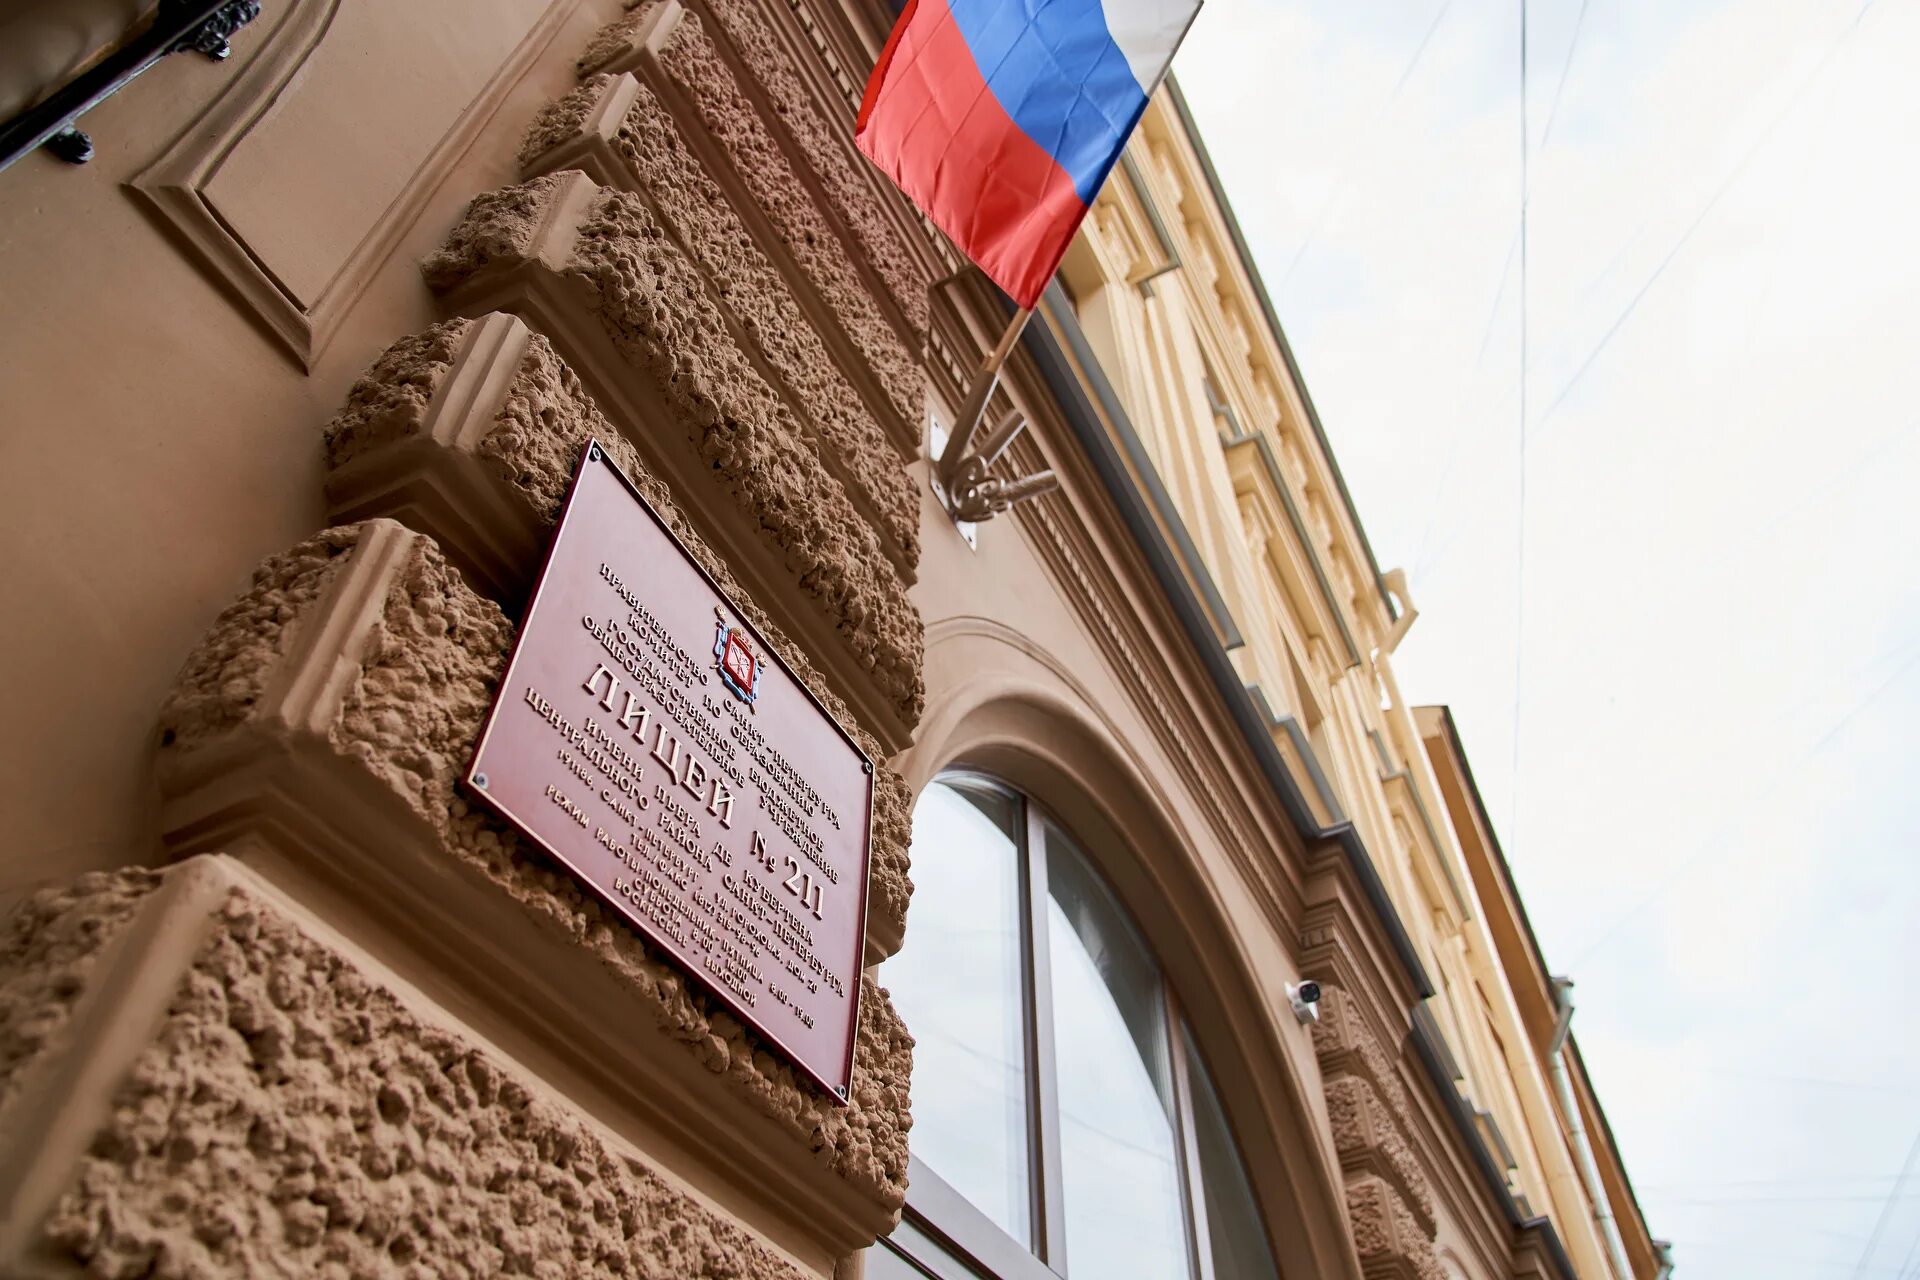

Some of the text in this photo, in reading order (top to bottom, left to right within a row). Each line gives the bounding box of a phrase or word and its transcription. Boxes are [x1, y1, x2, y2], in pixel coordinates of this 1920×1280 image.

[544, 781, 590, 831] РЕЖИМ
[579, 646, 737, 840] ЛИЦЕЙ
[781, 849, 826, 924] 211
[580, 611, 838, 888] ОБЩЕОБРАЗОВАТЕЛЬНОЕ УЧРЕЖДЕНИЕ
[598, 560, 841, 832] ПРАВИТЕЛЬСТВО САНКТ-ПЕТЕРБУРГА
[606, 616, 825, 856] ГОСУДАРСТВЕННОЕ БЮДЖЕТНОЕ
[626, 611, 815, 821] КОМИТЕТ ПО ОБРАЗОВАНИЮ
[523, 684, 845, 999] ЦЕНТРАЛЬНОГО РАЙОНА САНКТ-ПЕТЕРБУРГА
[583, 715, 814, 948] ИМЕНИ ПЬЕРА ДЕ КУБЕРТЕНА
[631, 874, 683, 929] СУББОТА
[692, 888, 716, 919] (812)
[715, 909, 761, 960] 315-98-96
[613, 875, 689, 951] ВОСКРЕСЕНЬЕ
[703, 951, 758, 1011] ВЫХОДНОЙ
[713, 890, 730, 915] УЛ.
[786, 956, 805, 985] ДОМ
[807, 976, 818, 997] 20
